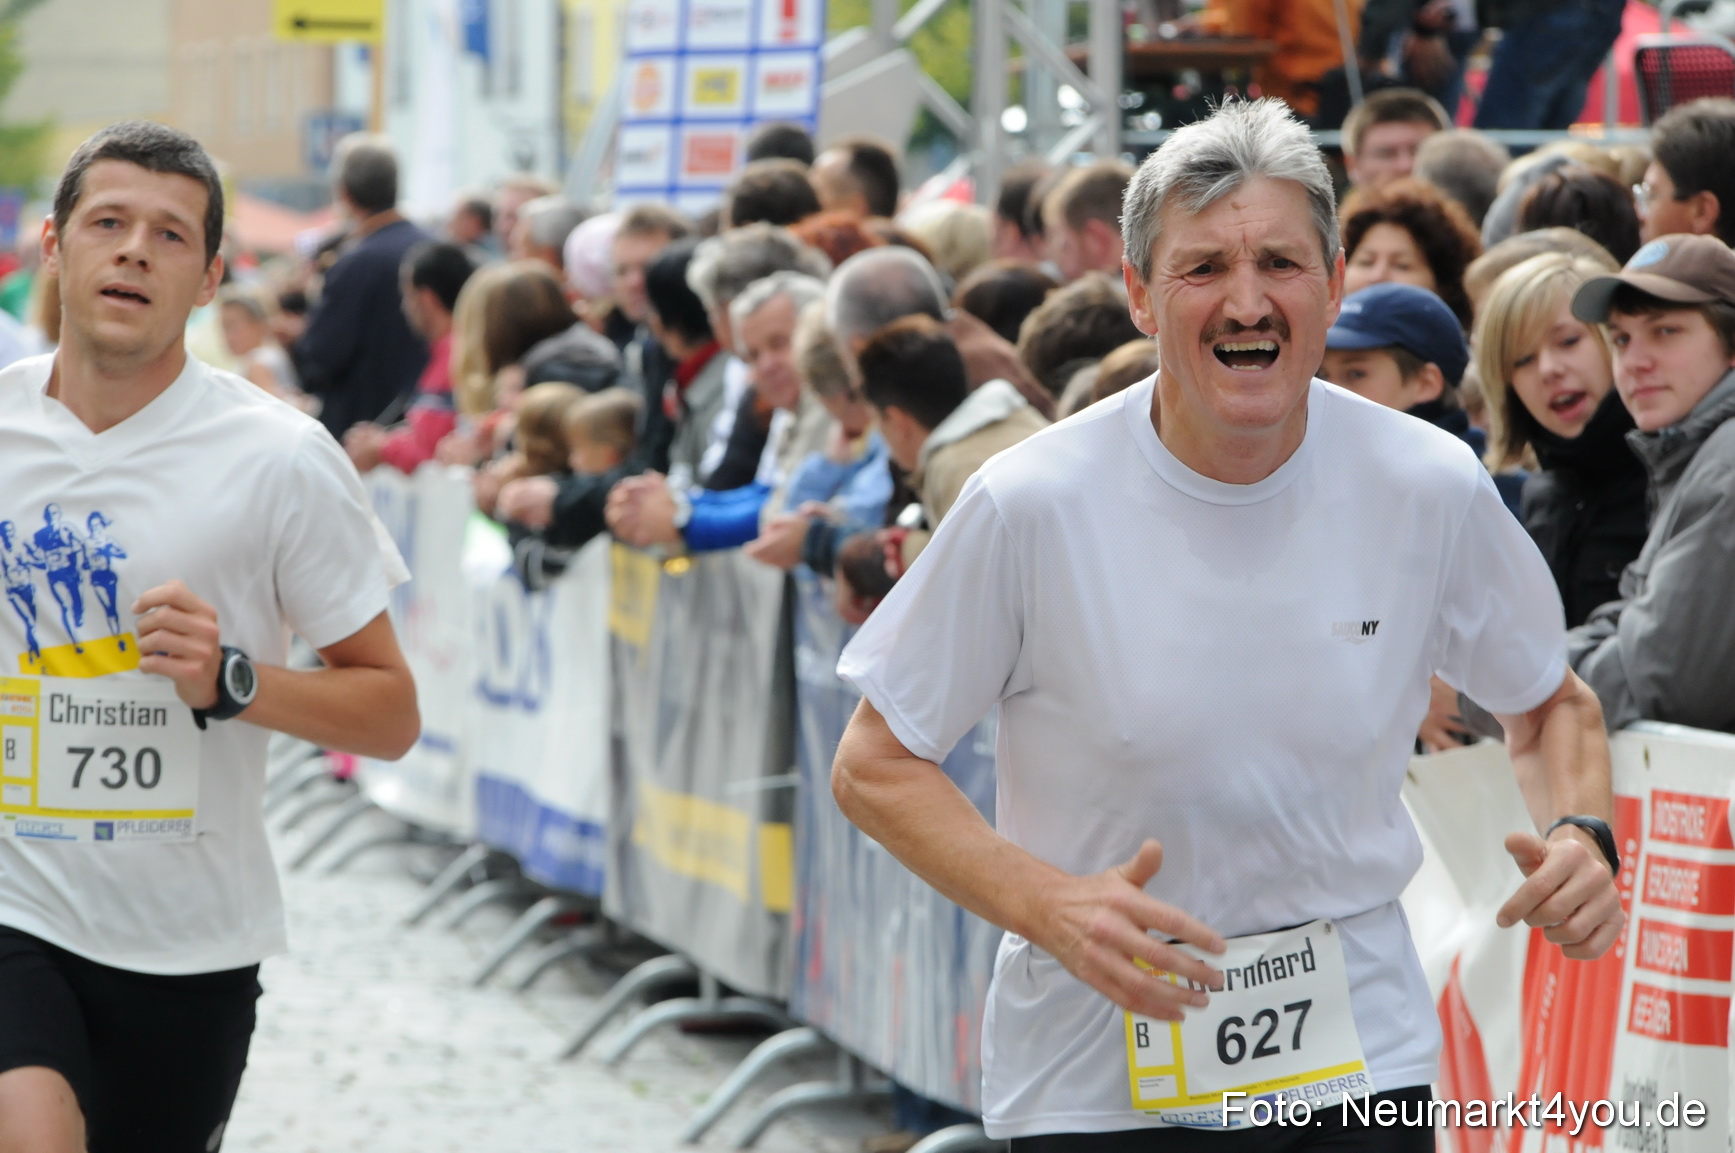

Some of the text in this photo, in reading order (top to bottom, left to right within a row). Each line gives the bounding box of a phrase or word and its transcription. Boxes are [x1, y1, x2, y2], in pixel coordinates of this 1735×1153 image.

[49, 693, 168, 727] Christian
[5, 738, 16, 760] B
[67, 746, 162, 790] 730
[116, 818, 193, 834] PFLEIDERER
[1135, 1021, 1150, 1049] B
[1216, 998, 1313, 1066] 627
[1280, 1072, 1369, 1105] PFLEIDERER
